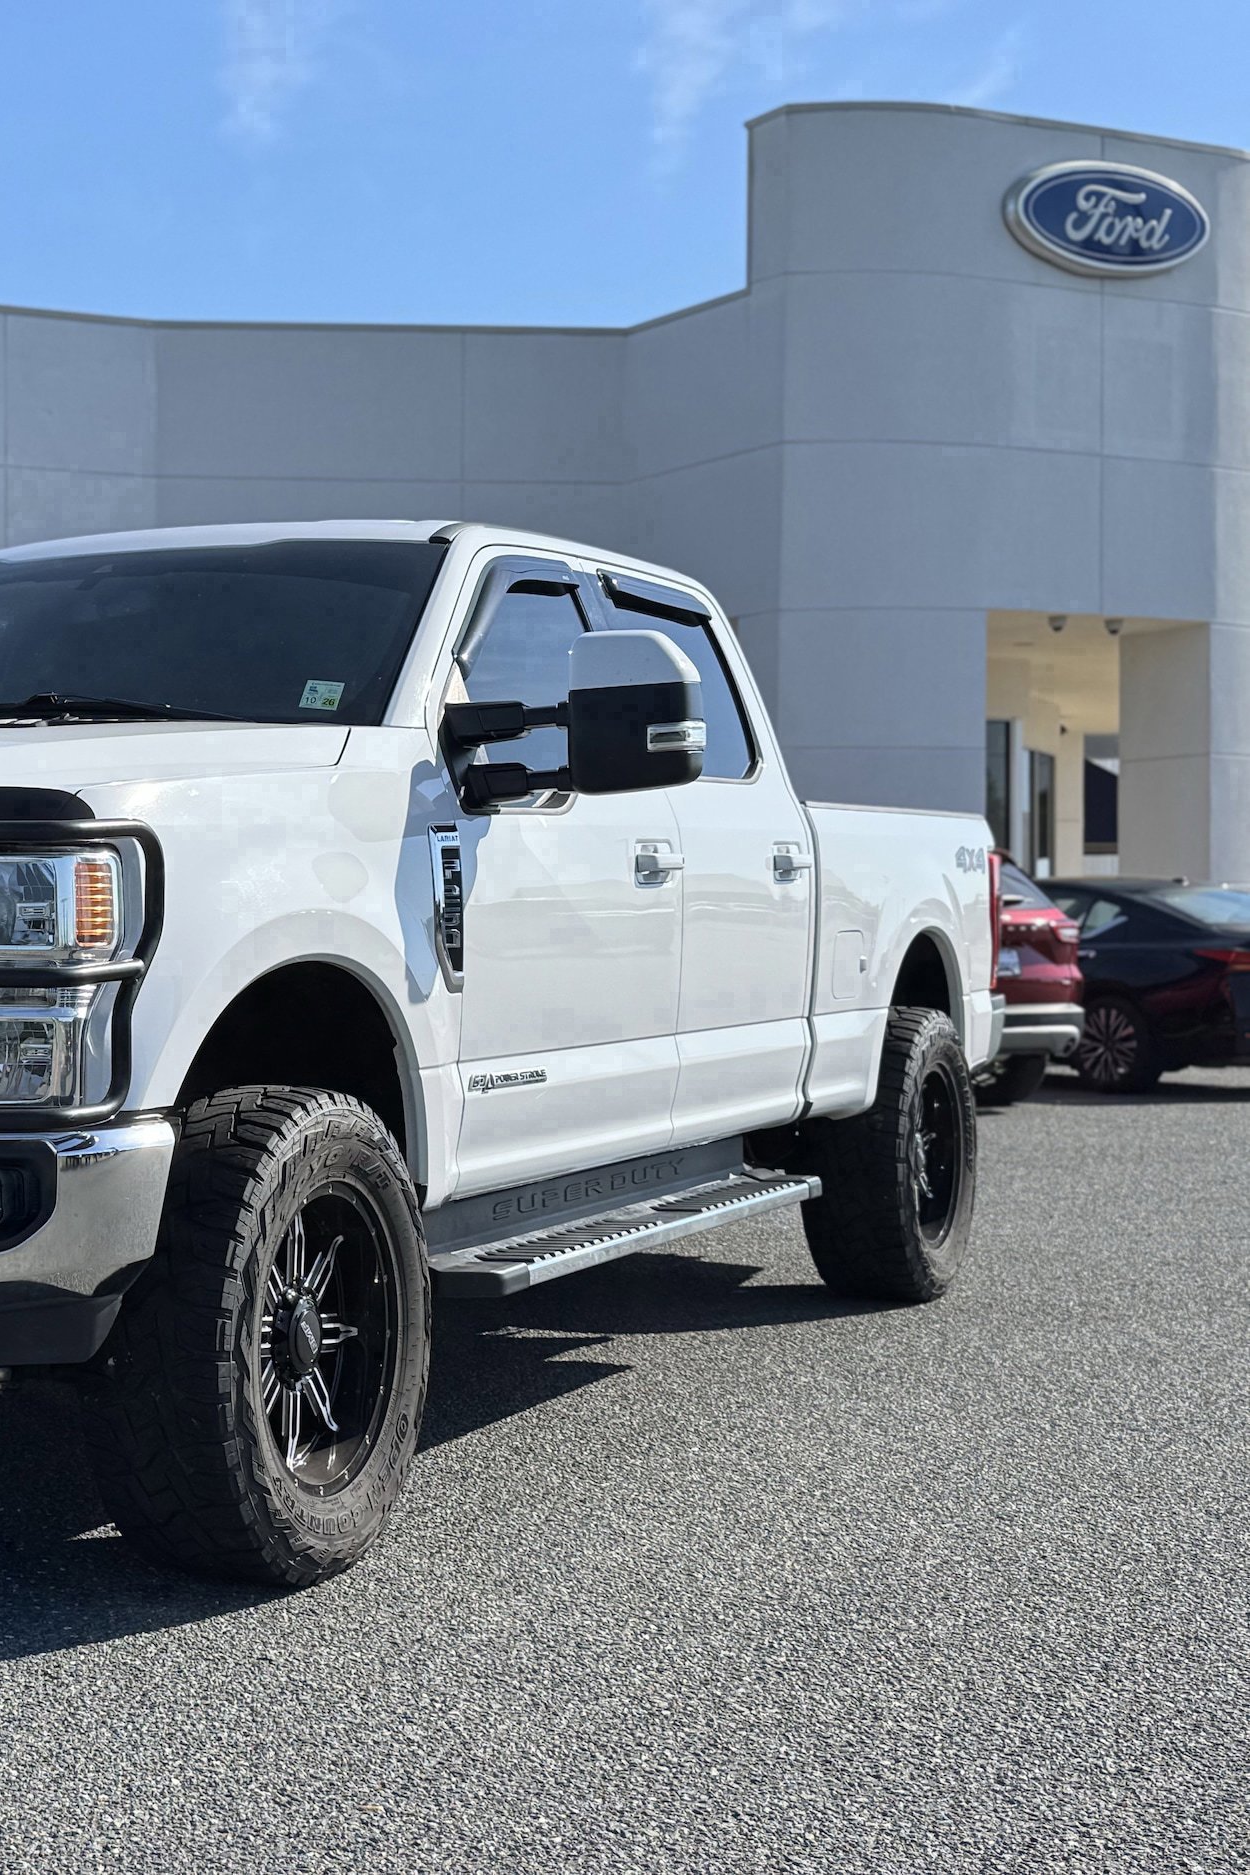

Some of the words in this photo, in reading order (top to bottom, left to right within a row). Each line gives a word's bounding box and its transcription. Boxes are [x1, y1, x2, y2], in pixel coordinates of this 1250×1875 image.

[1064, 183, 1173, 250] Ford
[492, 1178, 604, 1221] SUPER
[611, 1158, 685, 1191] DUTY
[366, 1412, 409, 1511] OPEN
